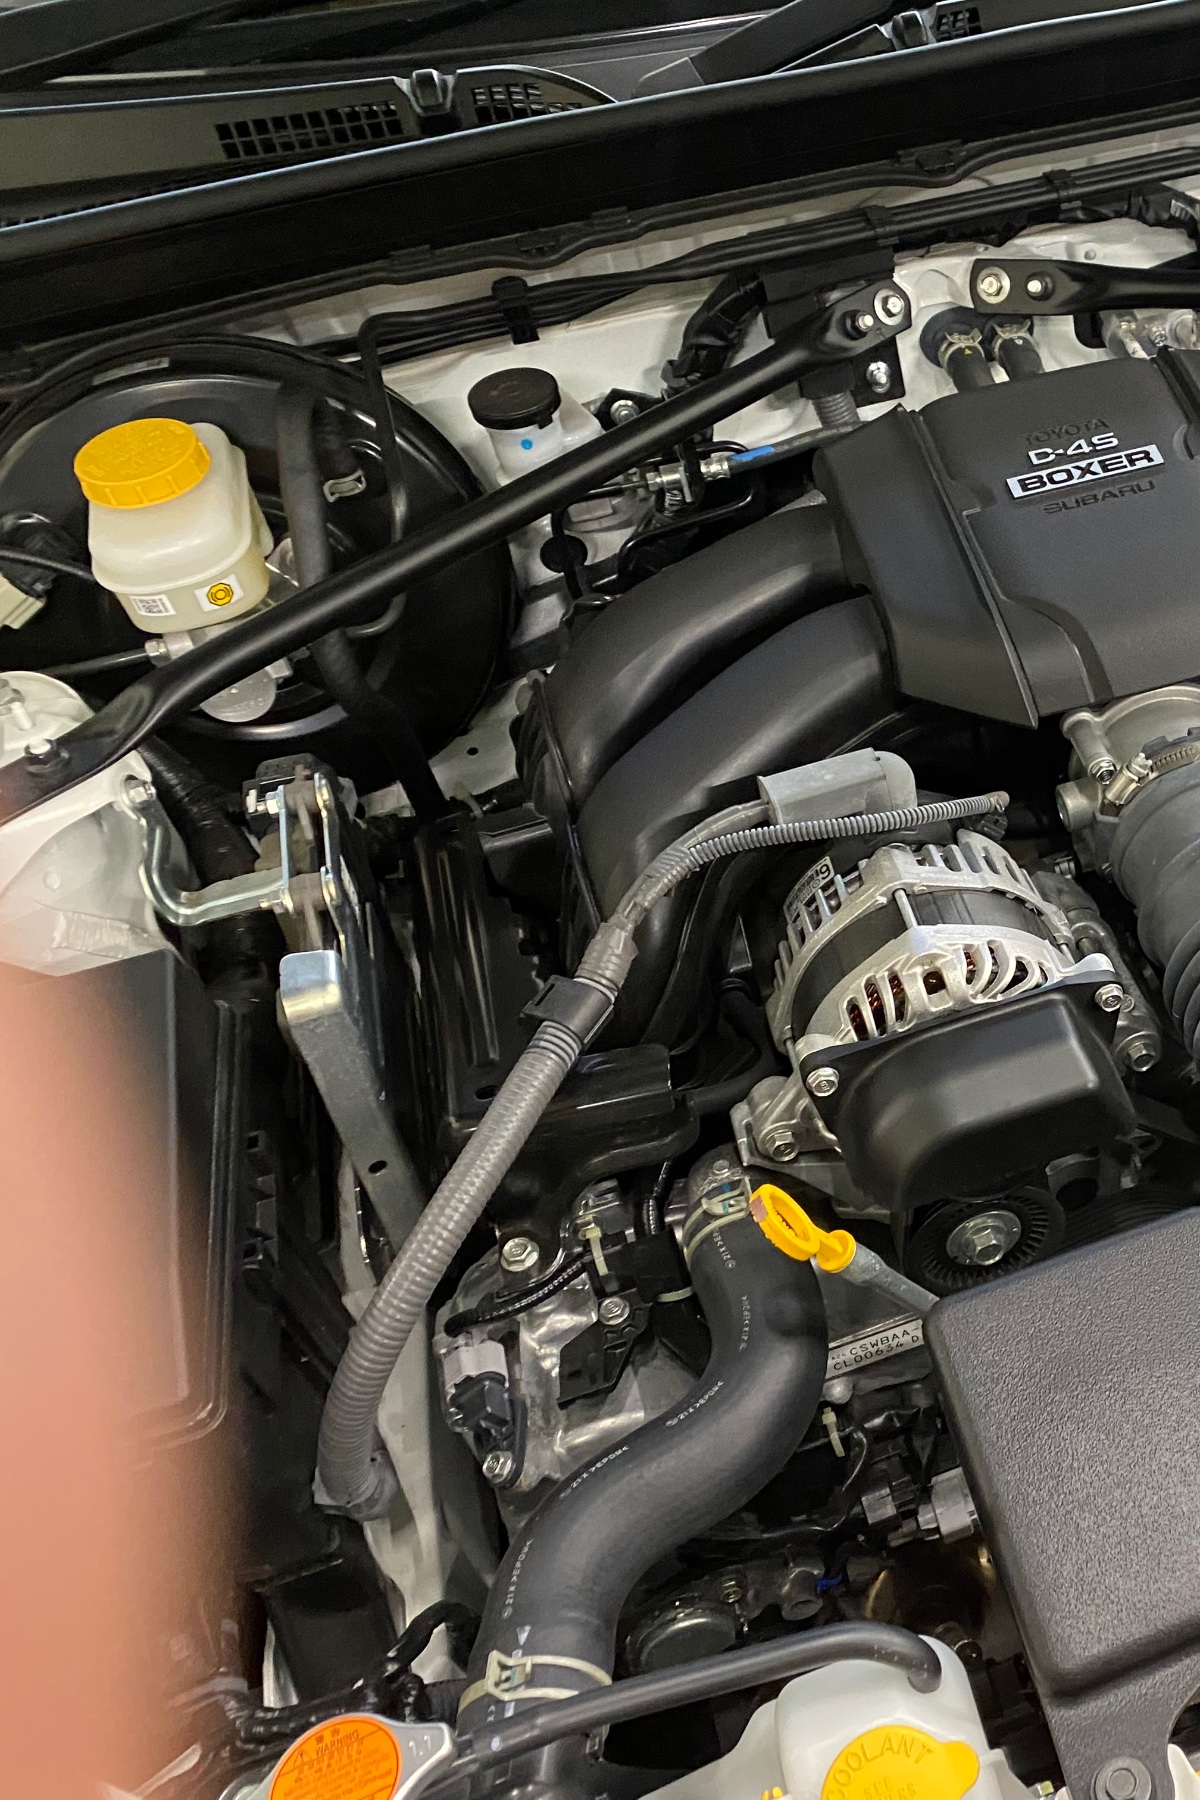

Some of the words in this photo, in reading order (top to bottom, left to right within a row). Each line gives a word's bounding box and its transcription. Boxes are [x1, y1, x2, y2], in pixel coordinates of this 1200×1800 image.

[1025, 417, 1110, 446] TOYOTA
[1027, 431, 1119, 466] D-4S
[1016, 449, 1155, 493] BOXER
[1042, 479, 1156, 515] SUBARU
[315, 1729, 360, 1758] WARNING
